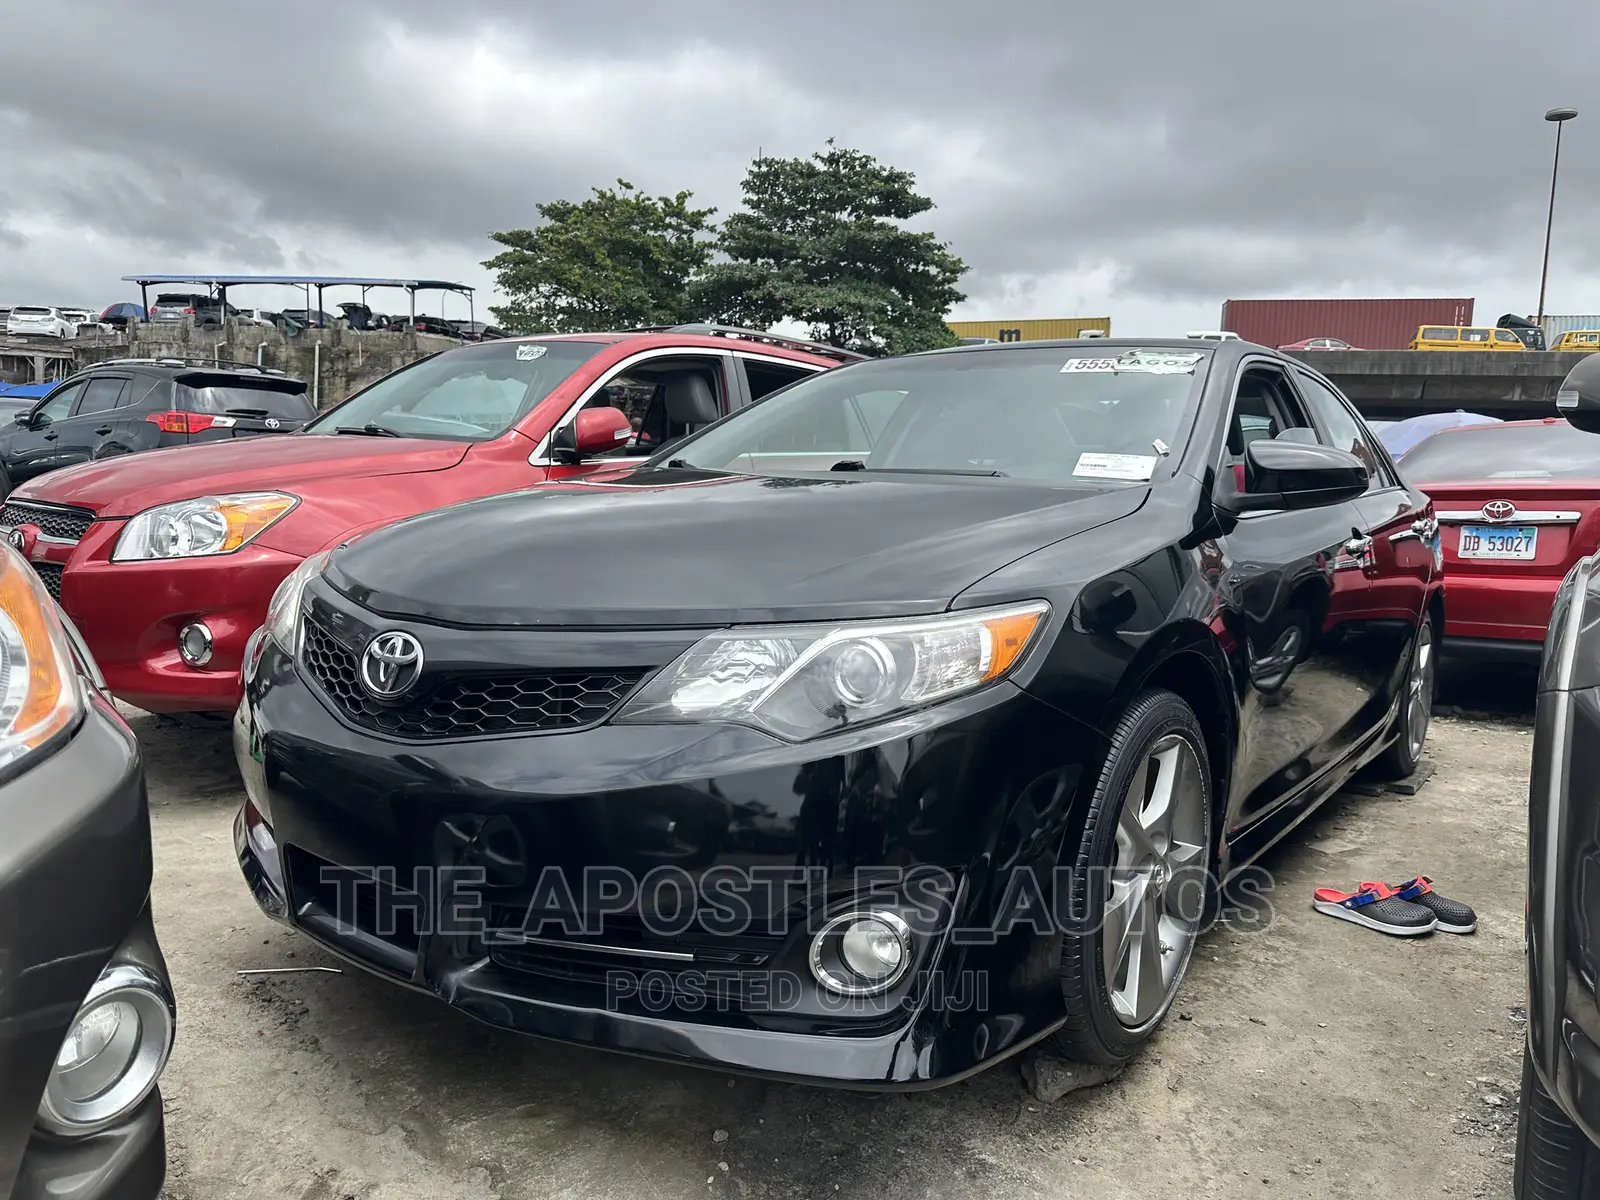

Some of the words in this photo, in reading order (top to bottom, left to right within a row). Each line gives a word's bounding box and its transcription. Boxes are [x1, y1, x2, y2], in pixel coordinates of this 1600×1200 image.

[999, 329, 1021, 342] m
[1074, 359, 1115, 370] 555
[1116, 358, 1193, 367] LAGOS
[1463, 535, 1481, 551] DB
[1488, 535, 1533, 552] 53027
